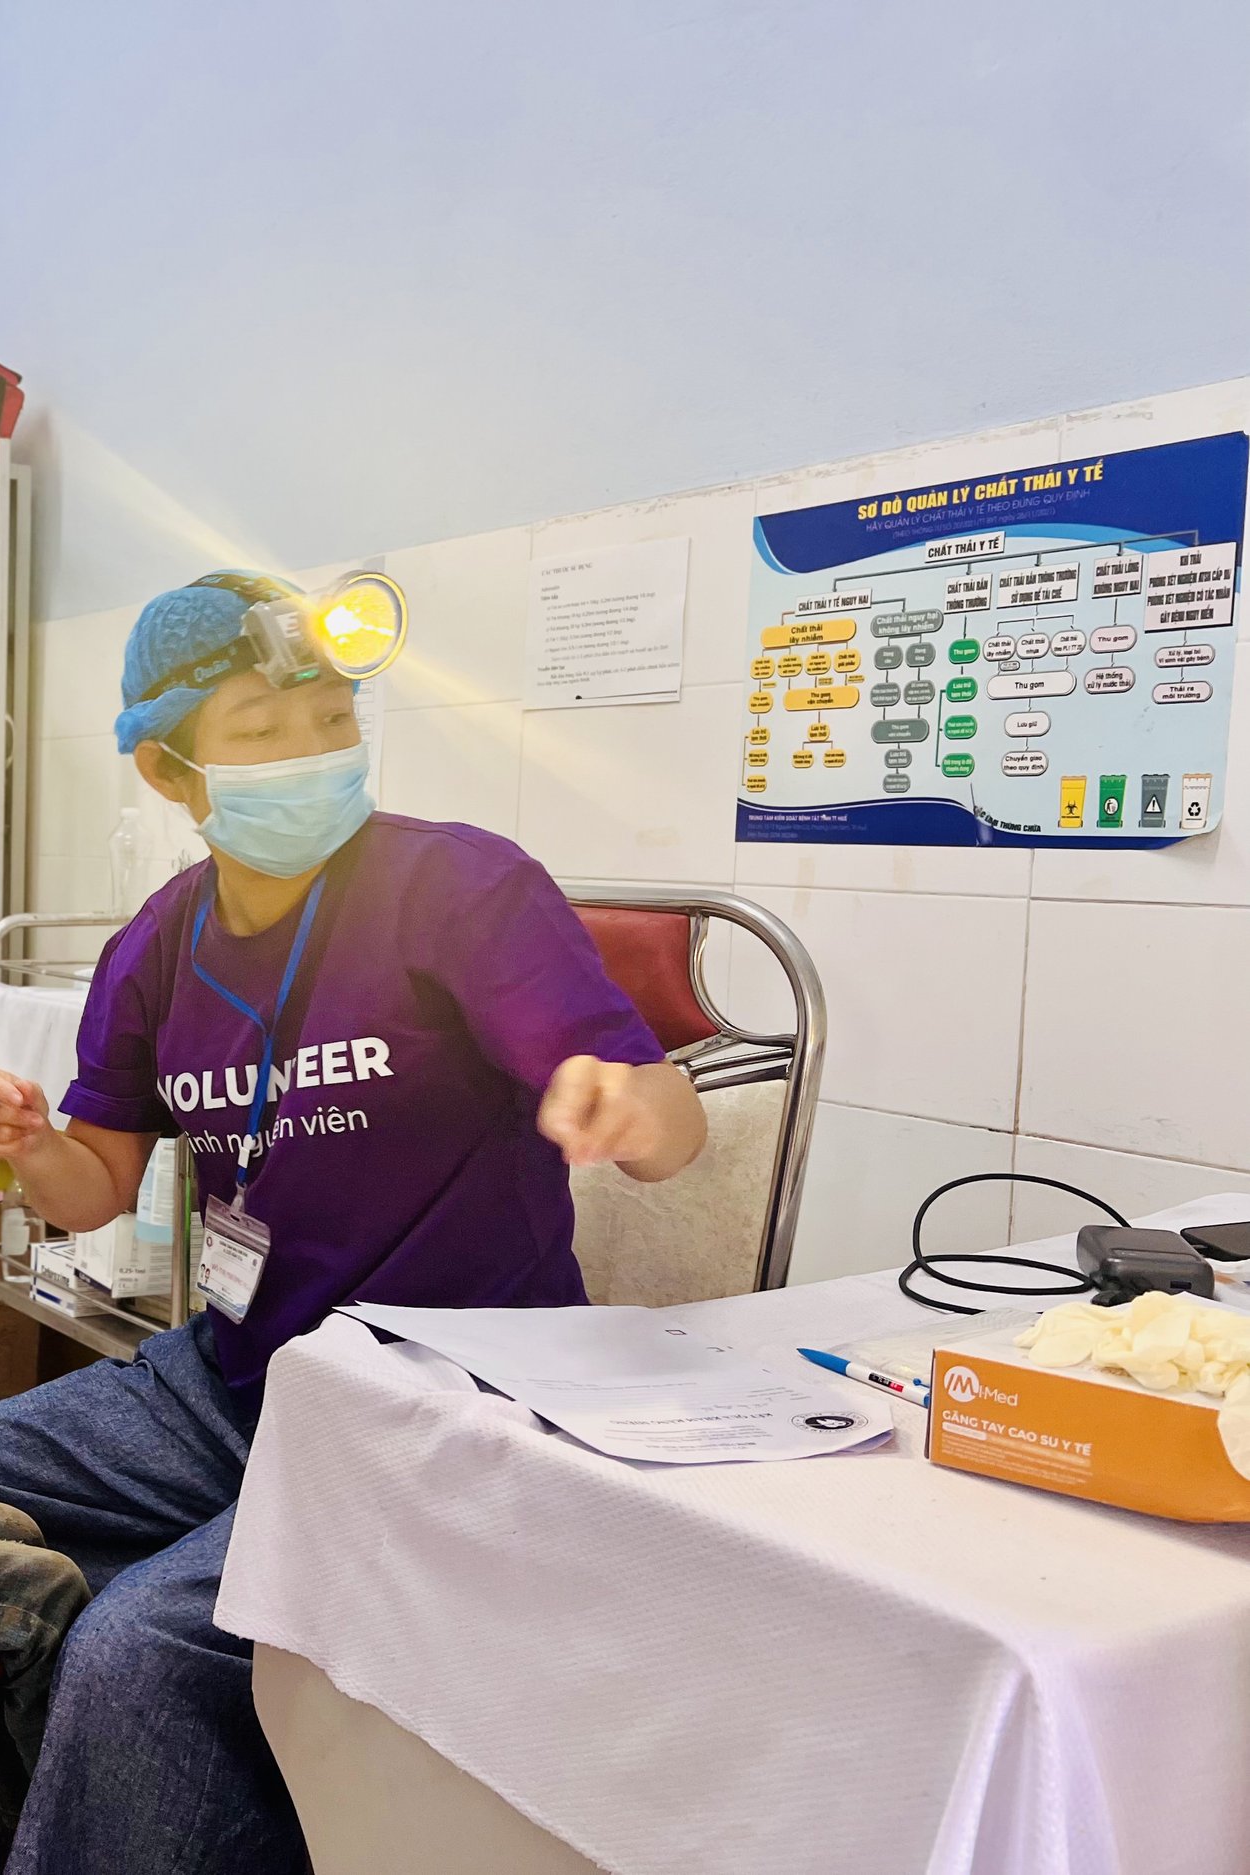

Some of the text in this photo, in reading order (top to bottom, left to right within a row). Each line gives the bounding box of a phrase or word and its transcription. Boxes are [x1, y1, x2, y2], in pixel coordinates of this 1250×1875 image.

[857, 500, 879, 520] SƠ
[1067, 468, 1079, 485] Y
[1083, 458, 1104, 483] TẾ
[979, 541, 986, 551] Y
[1014, 681, 1045, 692] Thu gom
[157, 1036, 394, 1113] VOLUNEER
[300, 1105, 368, 1136] viên
[981, 1419, 1006, 1434] TAY
[1008, 1427, 1038, 1443] CAO
[1039, 1434, 1059, 1448] SU
[1062, 1439, 1072, 1451] Y
